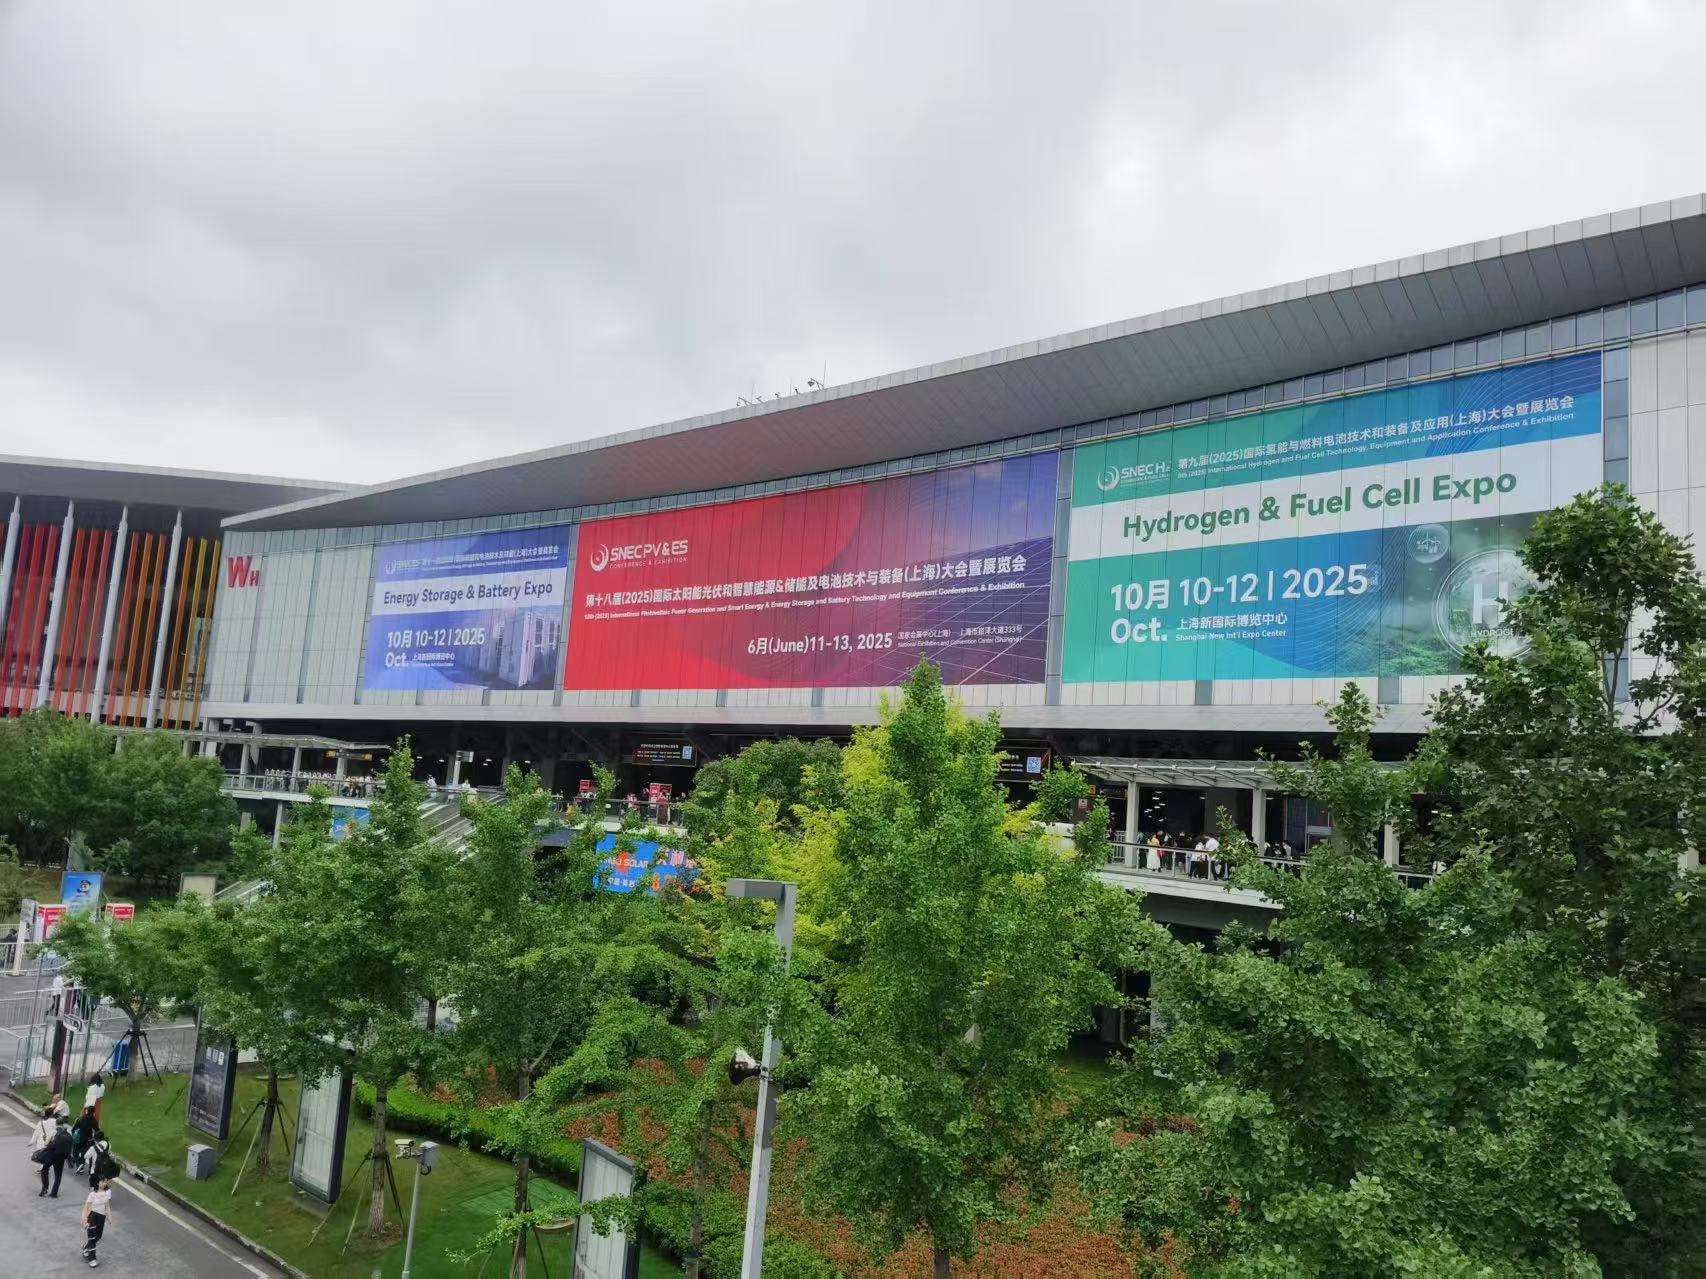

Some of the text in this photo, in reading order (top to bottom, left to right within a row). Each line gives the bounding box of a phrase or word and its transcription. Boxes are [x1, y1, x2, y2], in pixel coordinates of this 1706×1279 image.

[1208, 463, 1246, 473] International
[1248, 459, 1280, 469] Hydrogen
[1296, 452, 1309, 460] Fuel
[1312, 450, 1325, 458] Cell
[1369, 438, 1410, 449] Equipment
[1427, 429, 1471, 441] Application
[1473, 421, 1520, 434] Conference
[1531, 413, 1574, 425] Exhibition
[1121, 464, 1154, 479] SNEC
[1123, 472, 1517, 542] Hydrogen & Fuel Cell Expo
[384, 580, 552, 606] Energy Storage & Battery Expo
[852, 594, 887, 602] Technology
[902, 588, 938, 598] Equipment
[939, 584, 981, 595] Conference
[988, 581, 1025, 590] Exhibition
[1110, 580, 1170, 611] 10月
[1179, 572, 1259, 606] 10-12
[1282, 564, 1368, 600] 2025
[1110, 617, 1168, 644] Oct.
[1176, 612, 1288, 630] 上海新国际博览中心
[388, 631, 413, 648] 10月
[416, 630, 445, 646] 10-12
[455, 628, 485, 645] 2025
[857, 632, 893, 649] 2025
[1176, 633, 1208, 642] Shanghai
[1242, 631, 1260, 639] Expo
[385, 652, 409, 668] Oct.
